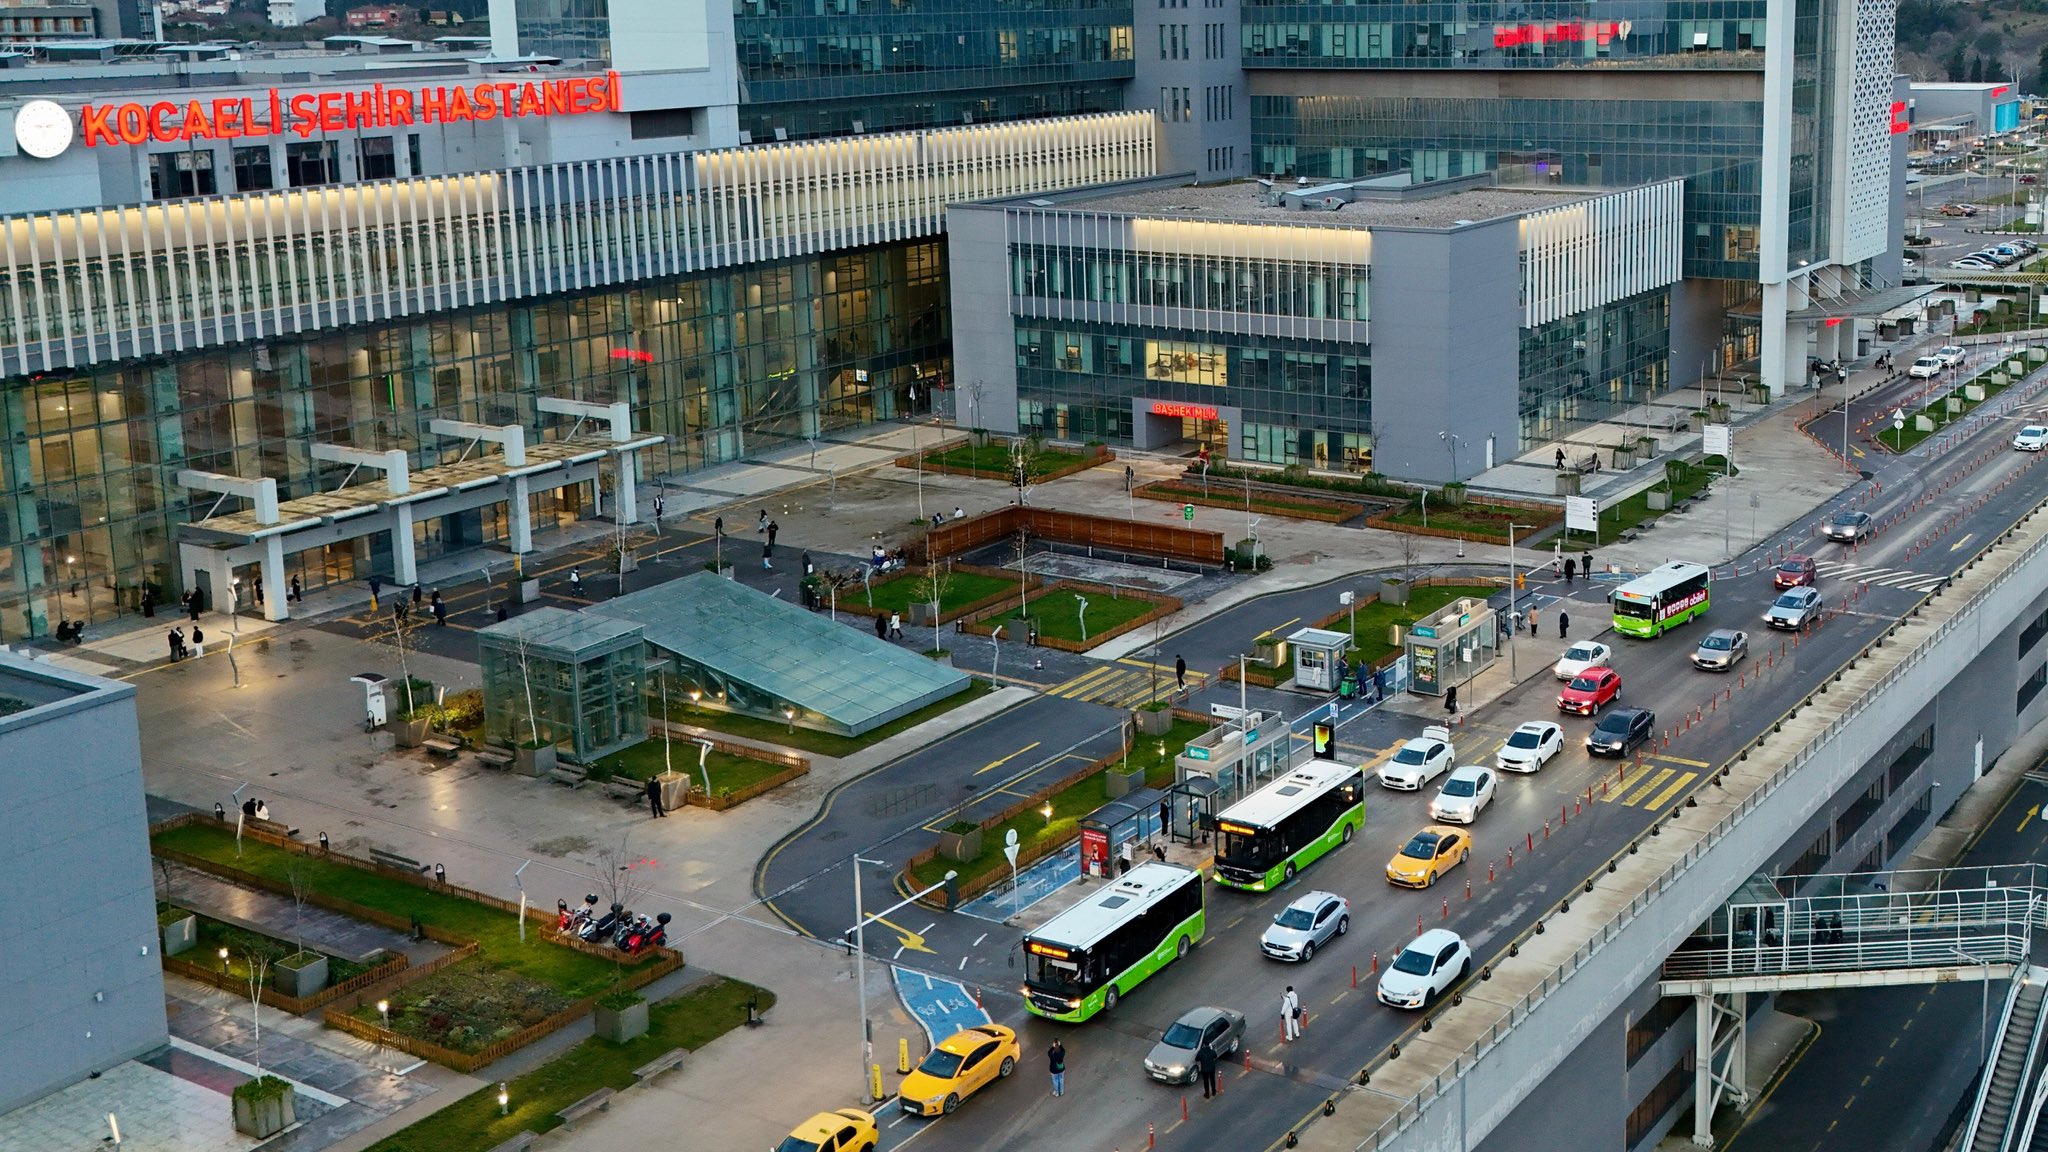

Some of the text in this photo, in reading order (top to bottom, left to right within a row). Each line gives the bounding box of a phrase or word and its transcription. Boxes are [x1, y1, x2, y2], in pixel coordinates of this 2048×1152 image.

[82, 70, 620, 148] KOCAELİ ŞEHİR HASTANESİ
[1689, 590, 1706, 606] obilet
